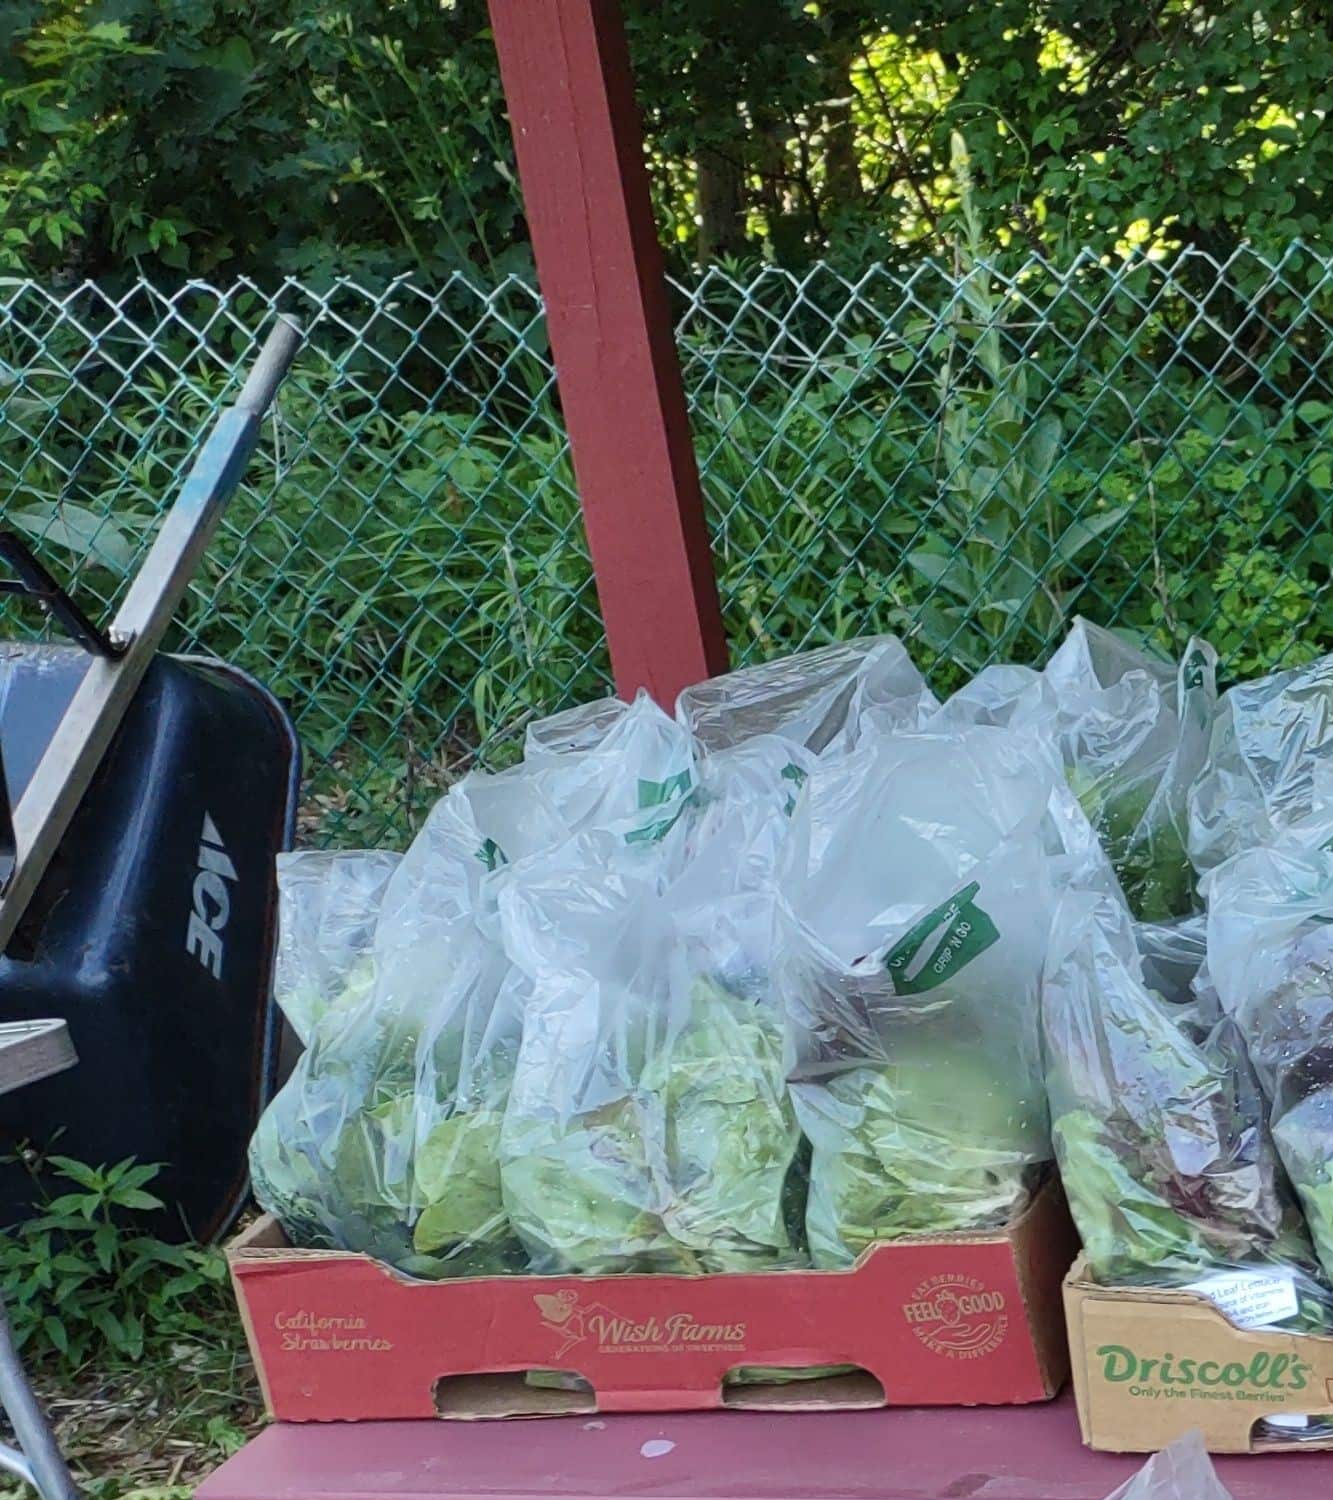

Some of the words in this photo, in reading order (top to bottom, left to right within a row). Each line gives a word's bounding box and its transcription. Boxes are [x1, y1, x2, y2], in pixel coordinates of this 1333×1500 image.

[186, 811, 239, 981] ACE
[274, 1310, 368, 1332] California
[903, 1300, 943, 1324] FEEL
[958, 1291, 1005, 1315] GOOD
[280, 1333, 394, 1351] Strawberries
[588, 1315, 662, 1345] Wish
[664, 1313, 747, 1345] Farms
[1095, 1344, 1314, 1390] Driscoll's
[1128, 1384, 1161, 1400] Only
[1163, 1386, 1187, 1399] the
